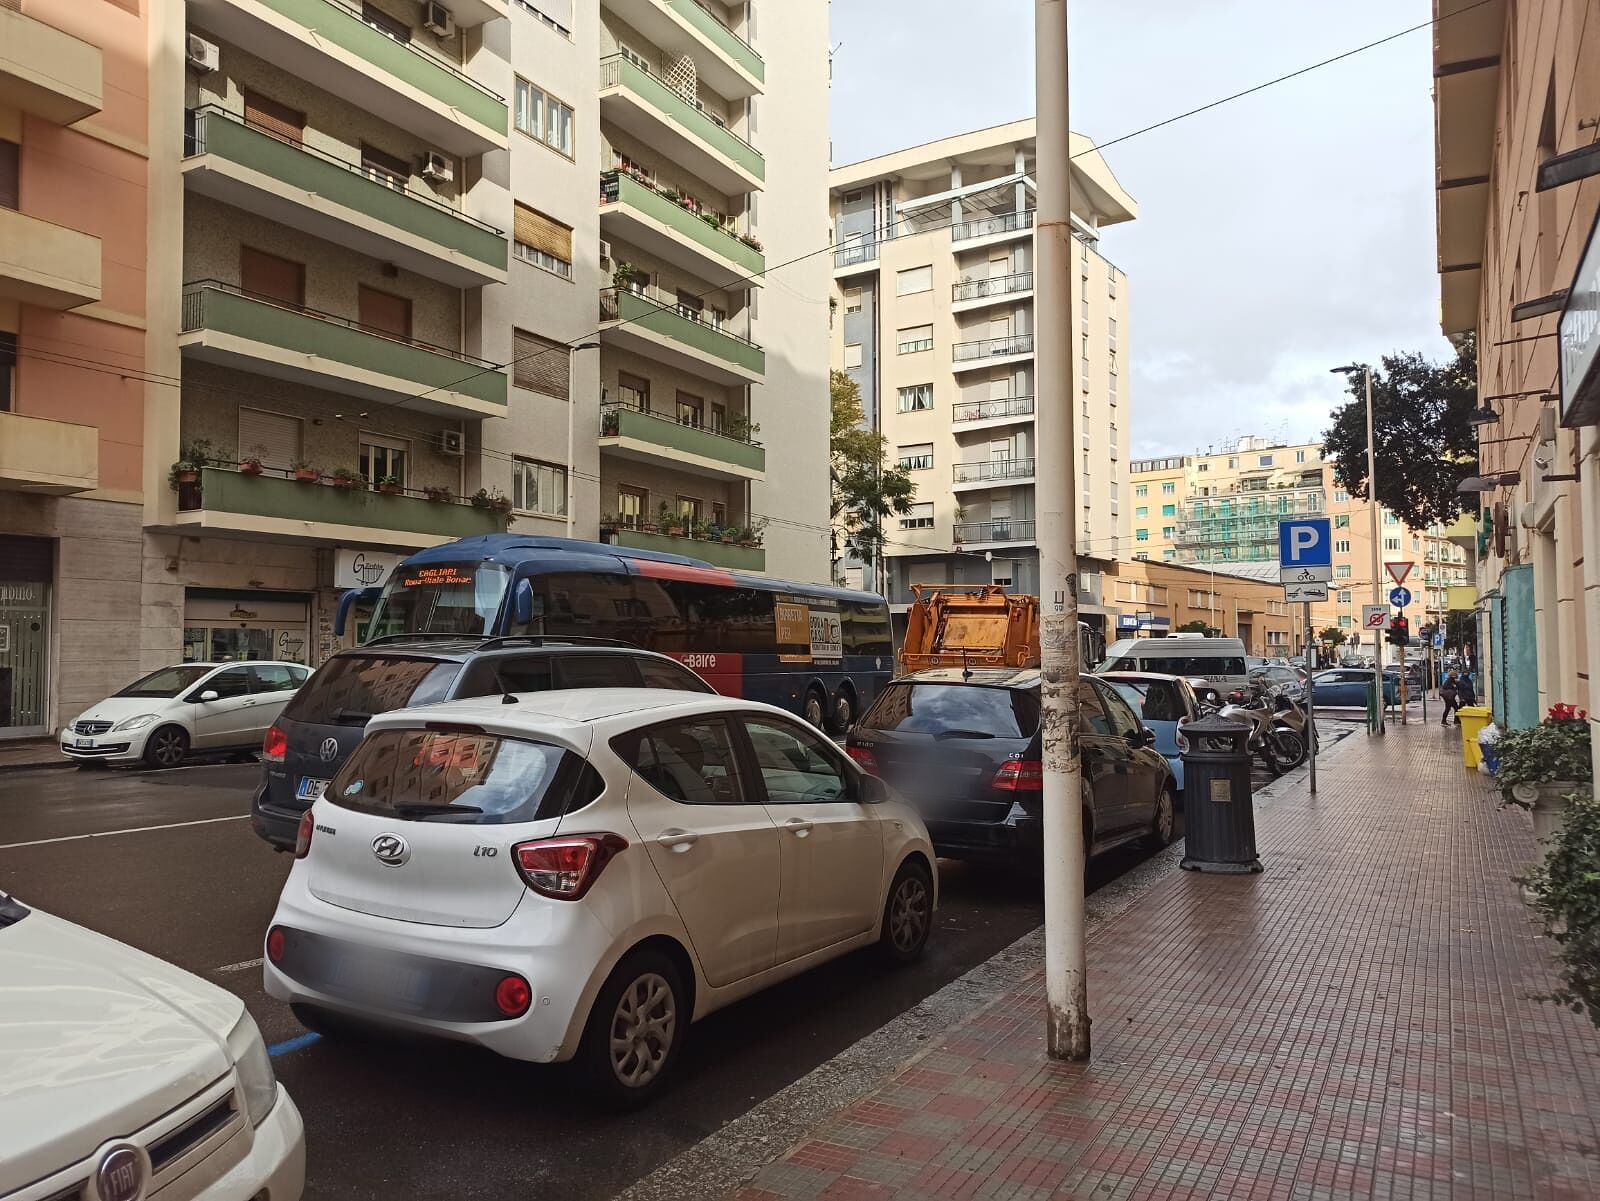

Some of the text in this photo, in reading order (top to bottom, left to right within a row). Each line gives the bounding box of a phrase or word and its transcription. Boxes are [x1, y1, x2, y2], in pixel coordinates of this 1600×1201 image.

[1290, 526, 1320, 561] P
[419, 568, 457, 577] CAGLIARI
[110, 1161, 134, 1196] FIAT
